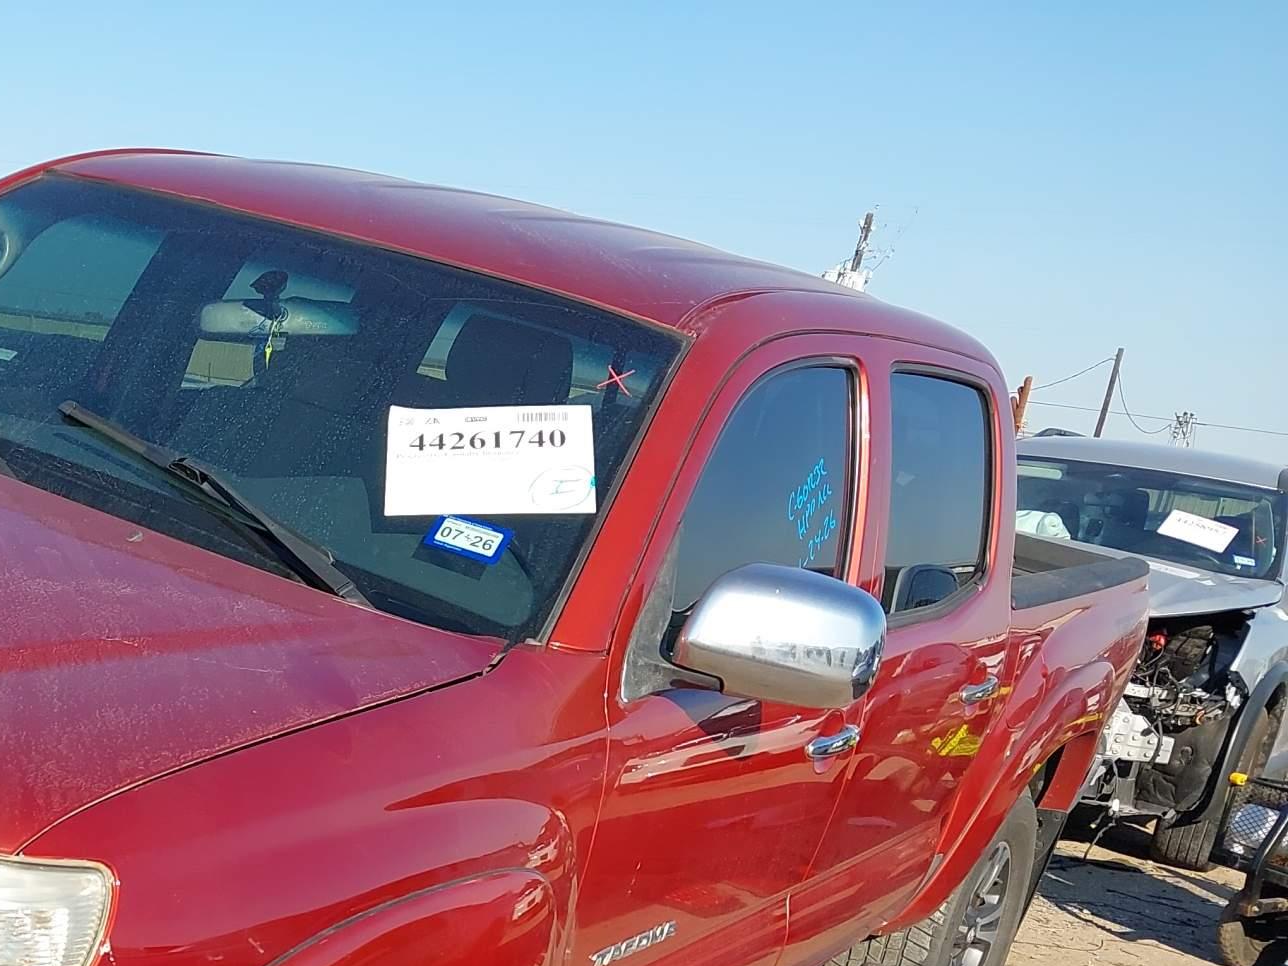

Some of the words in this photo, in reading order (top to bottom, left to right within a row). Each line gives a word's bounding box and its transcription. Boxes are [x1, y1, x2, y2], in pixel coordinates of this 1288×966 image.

[408, 429, 567, 451] 44261740
[440, 526, 464, 540] 07
[469, 535, 495, 551] 26
